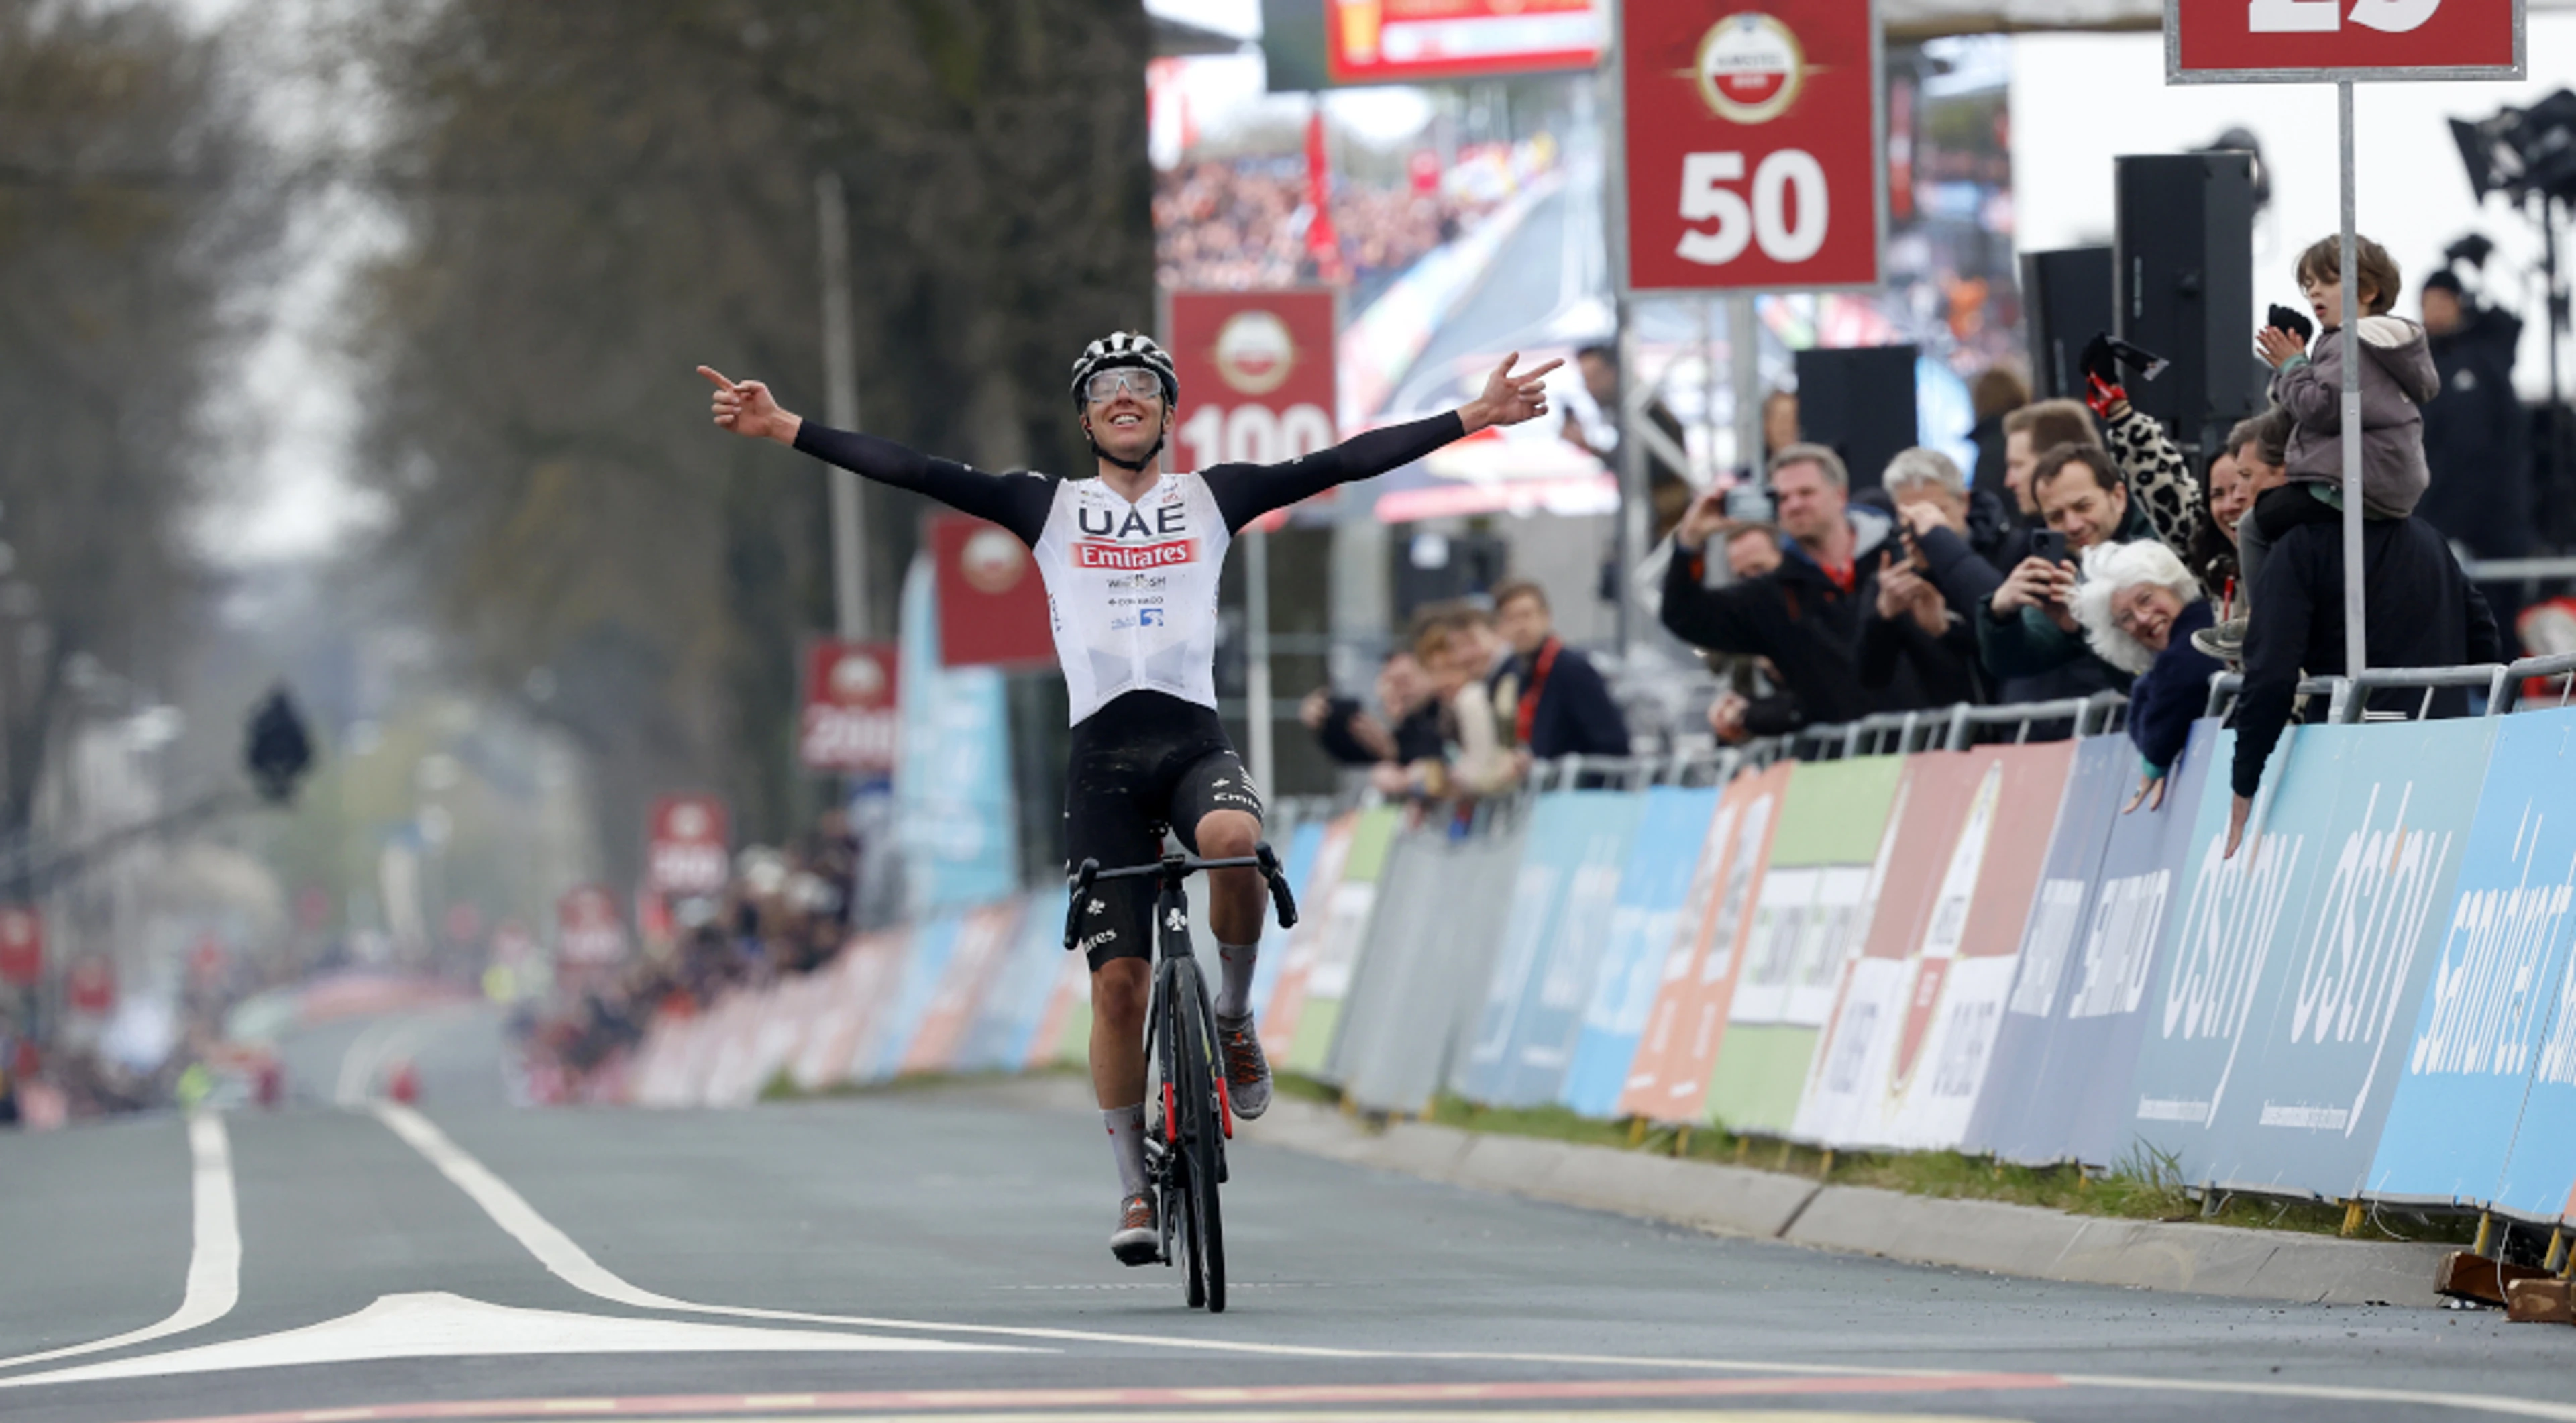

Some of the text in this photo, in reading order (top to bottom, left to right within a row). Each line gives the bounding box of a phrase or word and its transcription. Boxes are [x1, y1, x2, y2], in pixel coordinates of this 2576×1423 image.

[1675, 148, 1829, 265] 50
[1178, 403, 1334, 471] 100
[1079, 503, 1186, 537] UAE
[1081, 544, 1187, 568] Emirates
